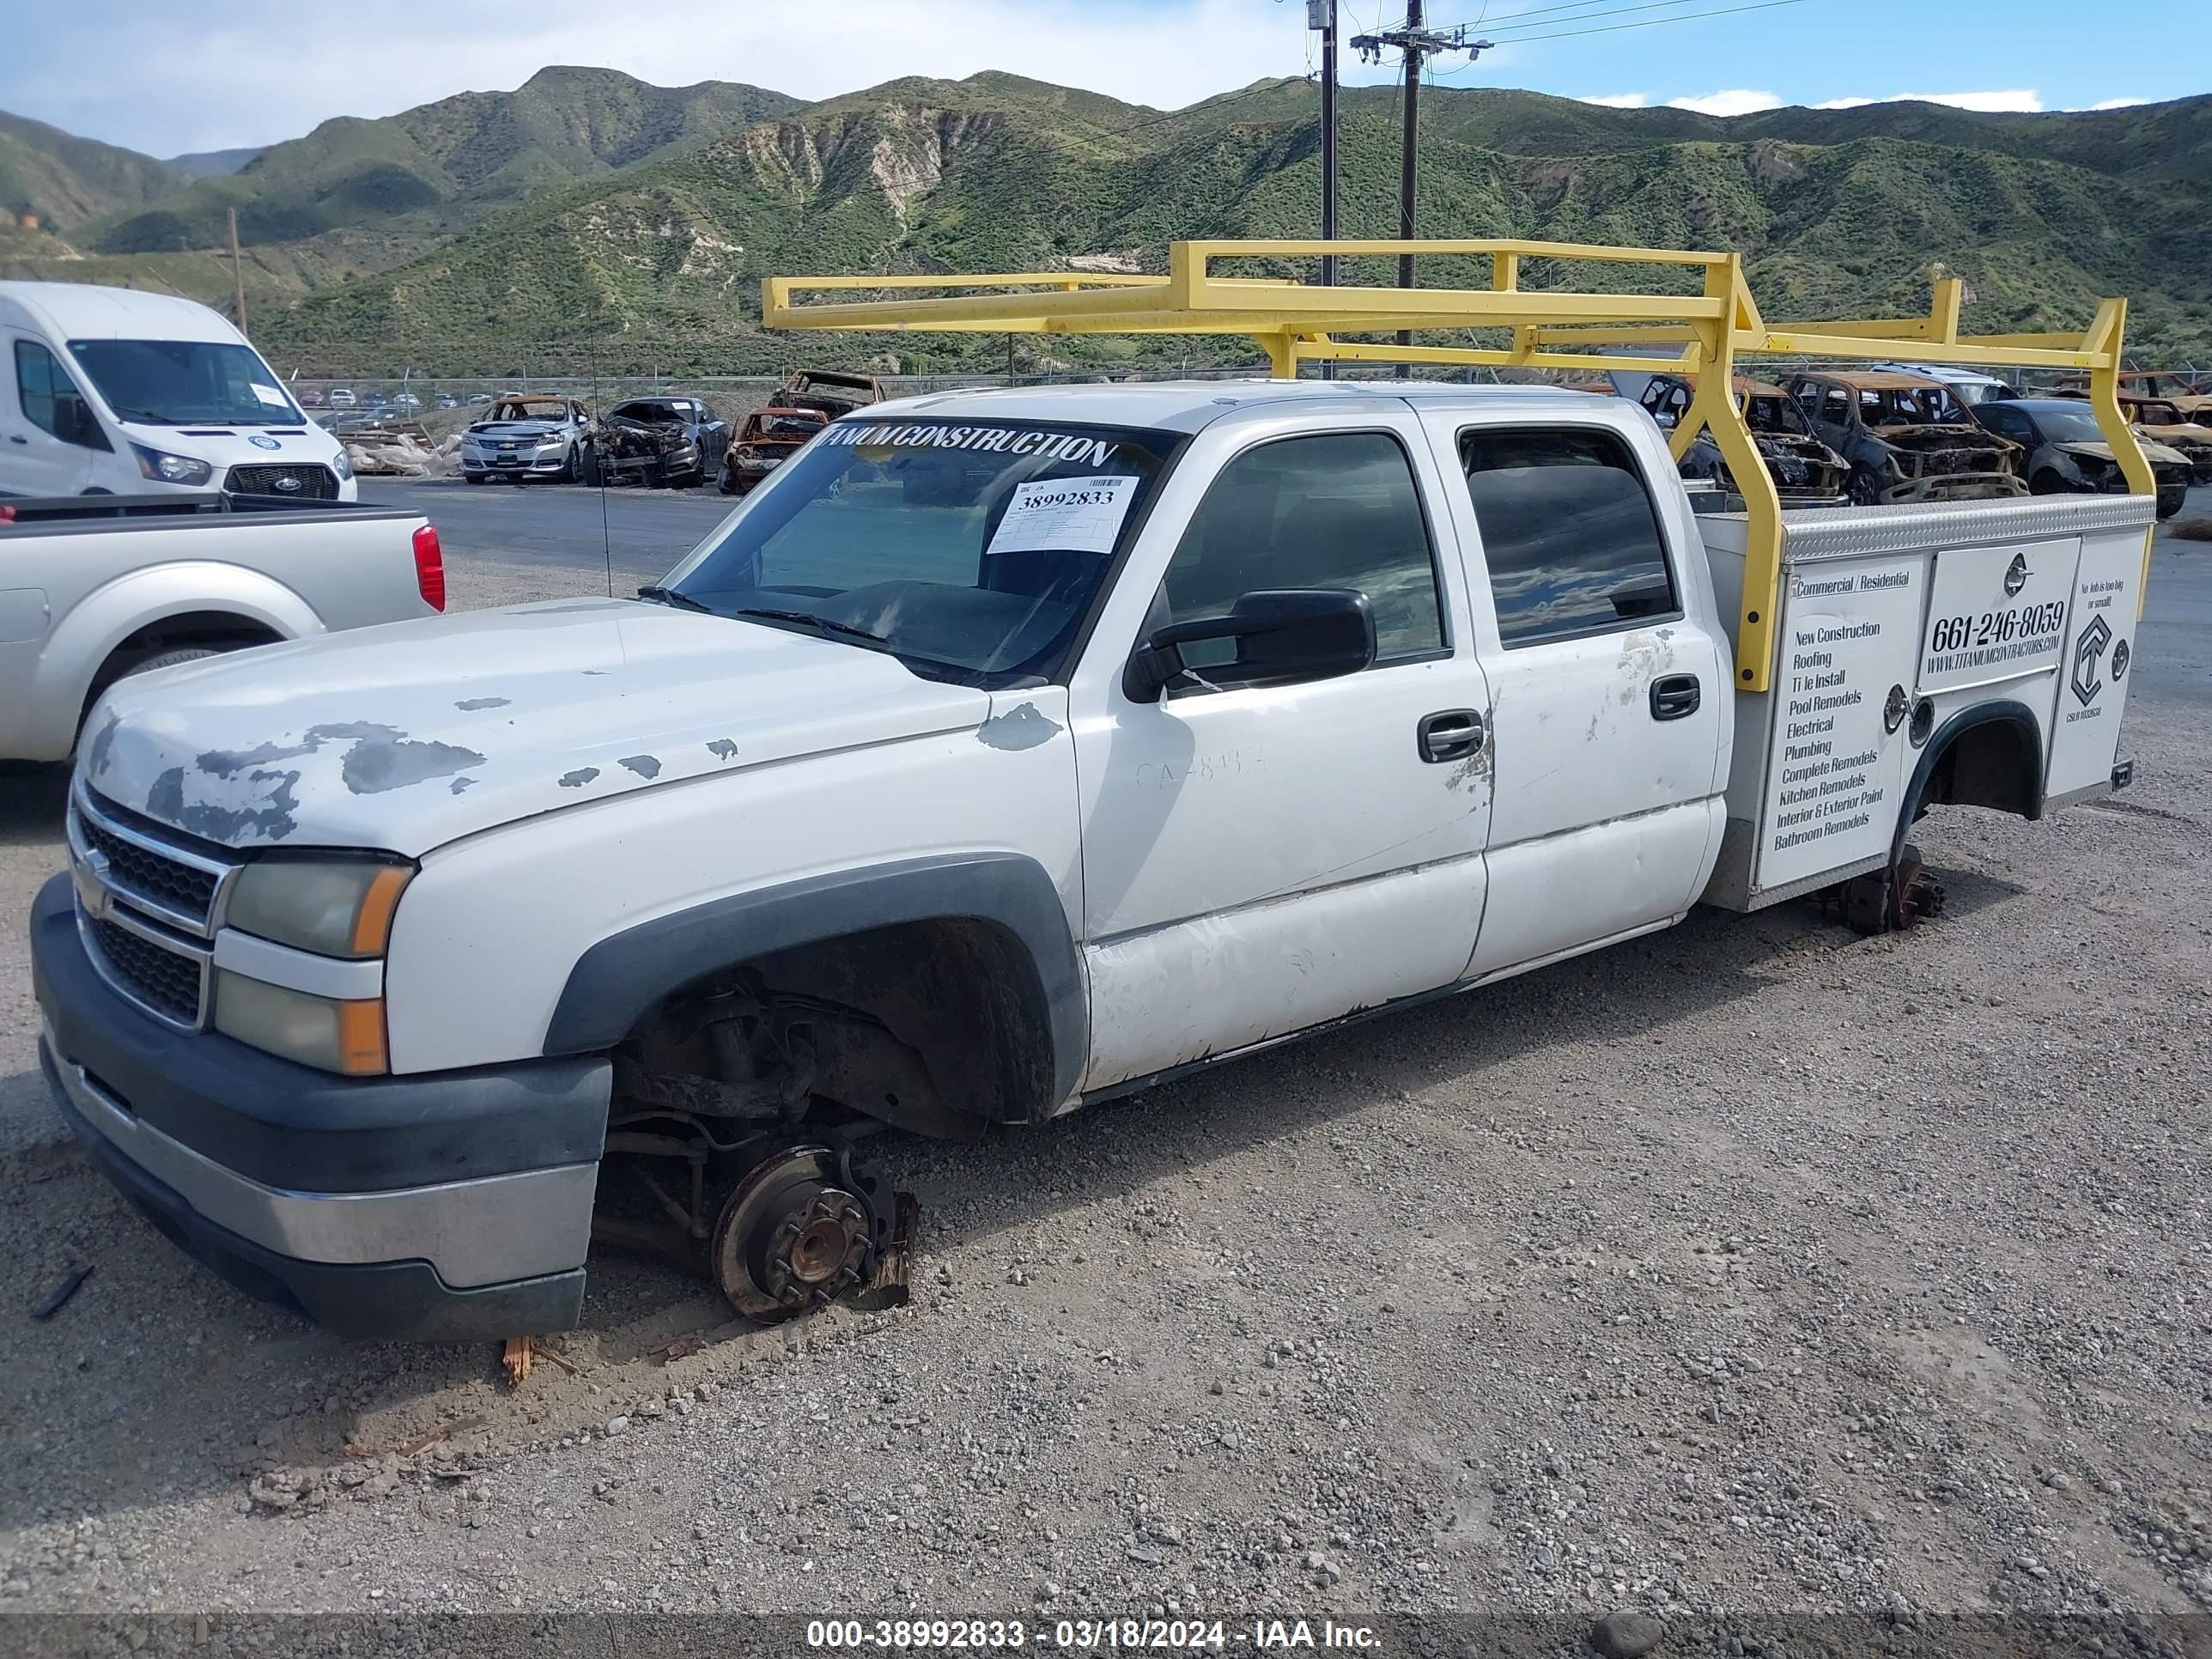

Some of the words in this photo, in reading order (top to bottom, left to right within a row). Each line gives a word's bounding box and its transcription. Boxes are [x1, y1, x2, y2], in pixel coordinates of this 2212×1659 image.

[893, 426, 1120, 468] CONSTRUCTION
[1018, 491, 1115, 510] 38992833
[1797, 576, 1854, 597] Commercial
[1860, 571, 1910, 590] Residential
[2089, 582, 2100, 592] Job
[2099, 580, 2105, 592] is
[2106, 580, 2114, 591] too
[2114, 579, 2124, 592] big
[2087, 600, 2094, 609] or
[1796, 631, 1815, 646] New
[1817, 622, 1881, 643] Construction
[1932, 600, 2064, 652] 661-246-8059
[1793, 652, 1832, 670] Roofing
[1927, 635, 2060, 674] WWW.TITANIUMCONTRACTORS.COM
[1815, 670, 1846, 689] Install
[1790, 698, 1813, 716] Pool
[1815, 690, 1862, 710] Remodels
[1787, 715, 1834, 738] Electrical
[1784, 740, 1832, 762] Plumbing
[1782, 762, 1830, 784] Complete
[1831, 750, 1878, 772] Remodels
[1779, 787, 1818, 806] Kitchen
[1819, 773, 1866, 796] Remodels
[1777, 808, 1814, 829] Interior
[1815, 804, 1822, 817] &
[1823, 797, 1860, 816] Exterior
[1861, 788, 1883, 806] Paint
[1774, 826, 1823, 851] Bathroom
[1824, 812, 1870, 836] Remodels
